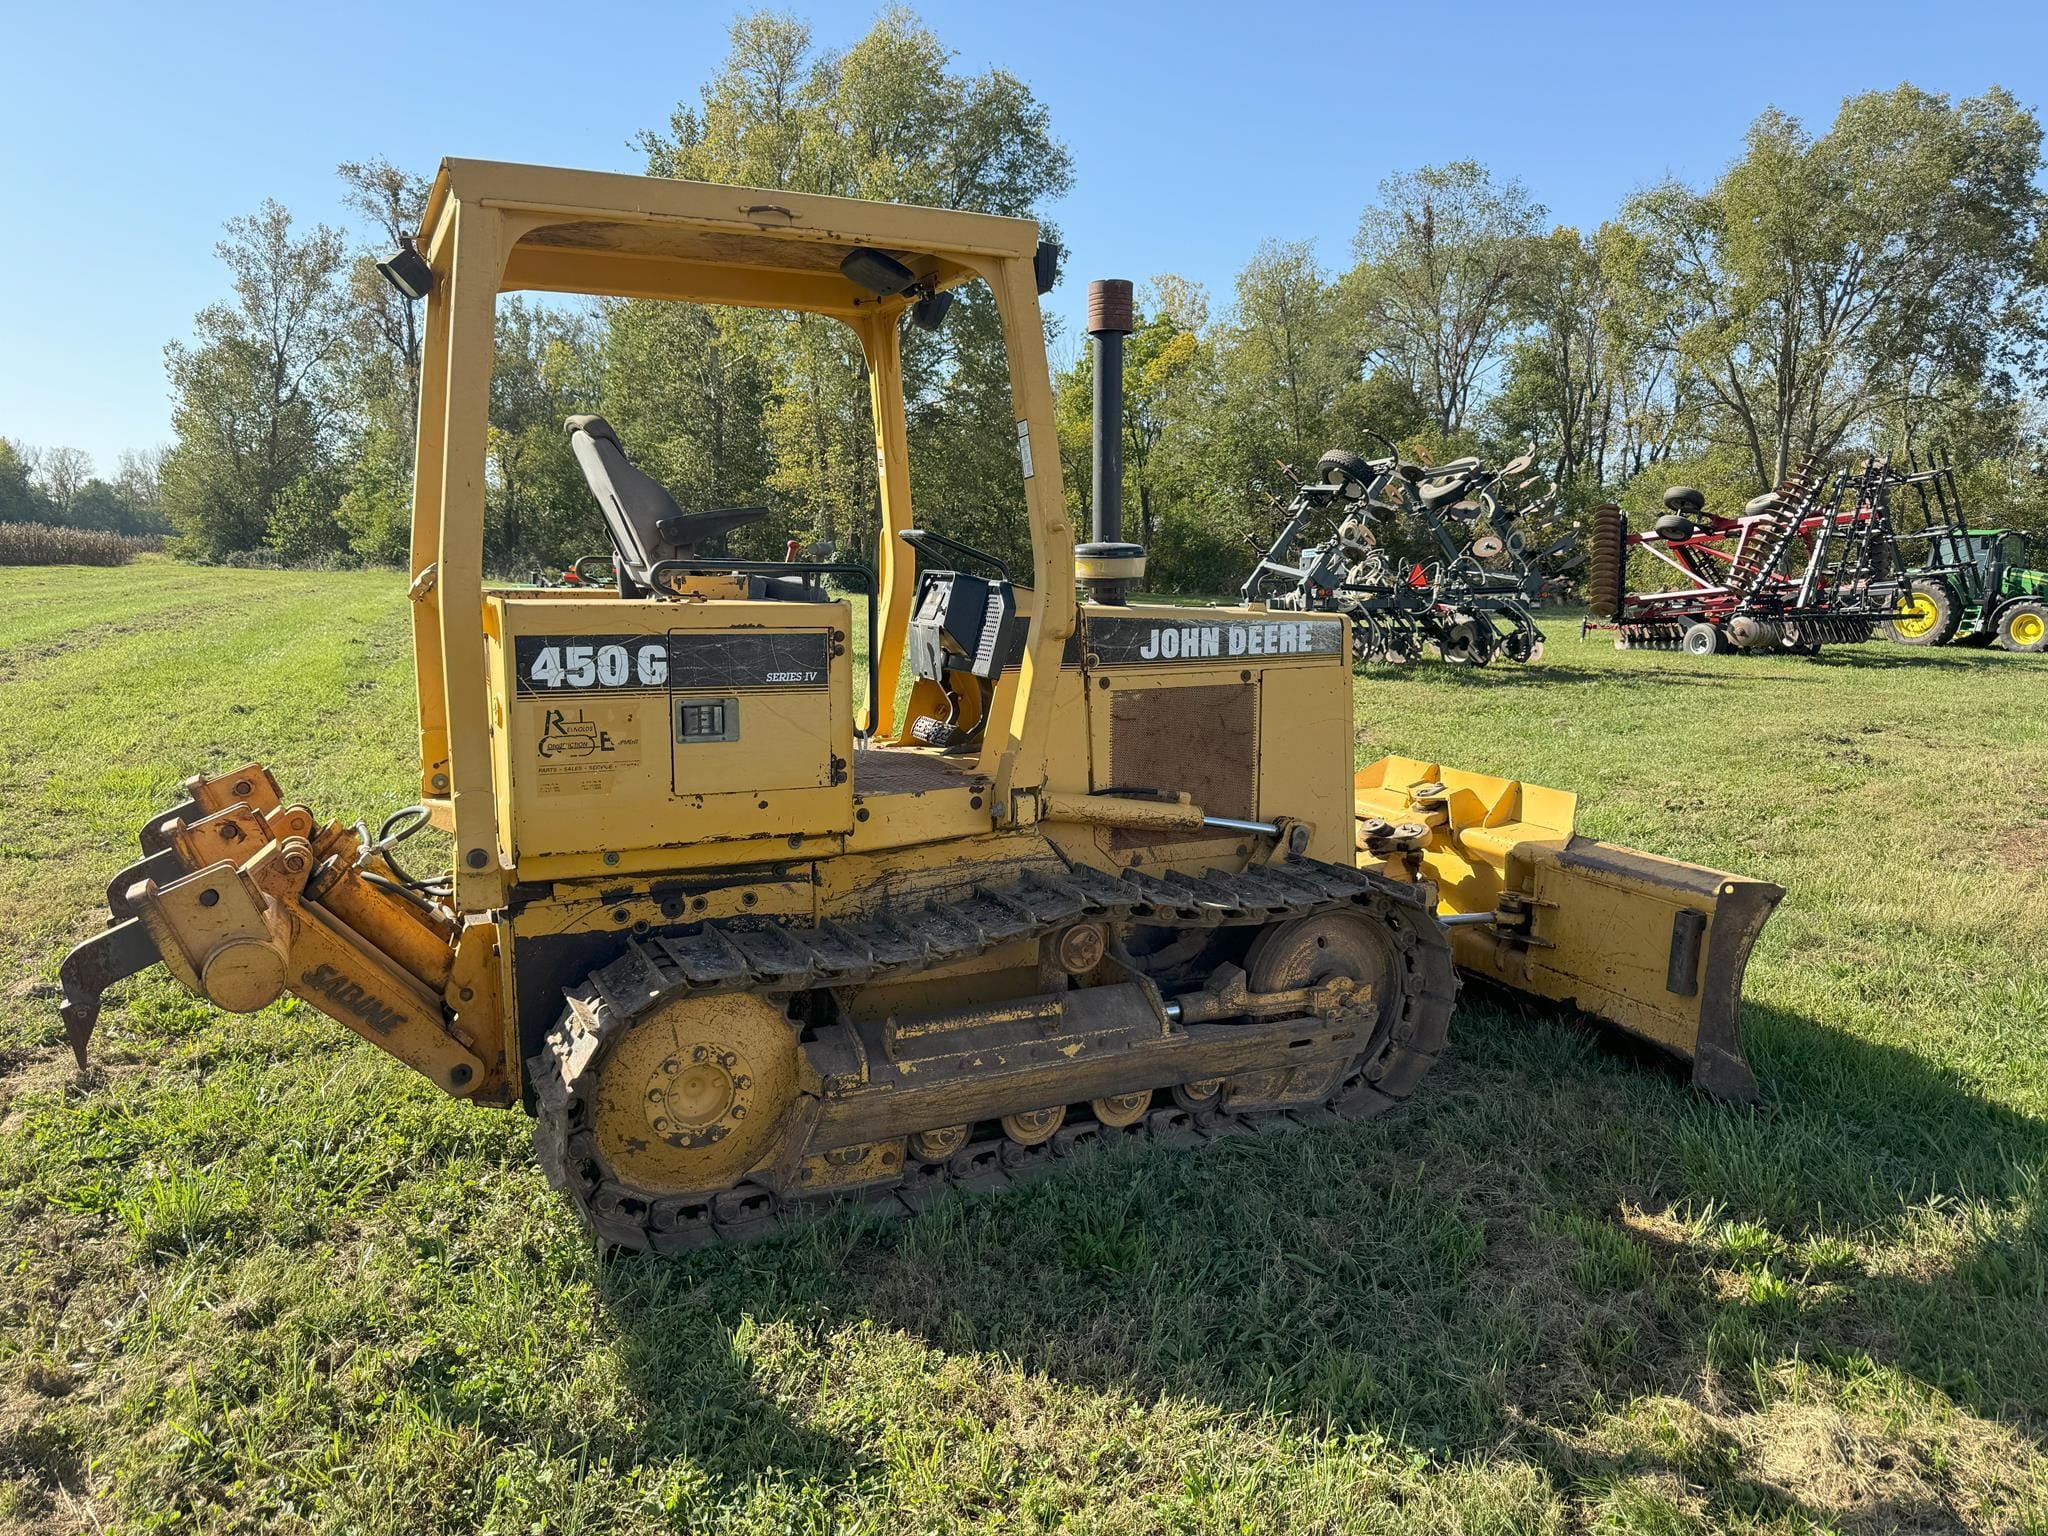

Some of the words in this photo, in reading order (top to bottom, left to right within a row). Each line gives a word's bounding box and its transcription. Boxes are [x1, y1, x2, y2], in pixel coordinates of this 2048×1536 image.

[1140, 627, 1220, 660] JOHN
[1228, 622, 1312, 657] DEERE
[766, 672, 802, 682] SERIES
[803, 671, 818, 681] IV
